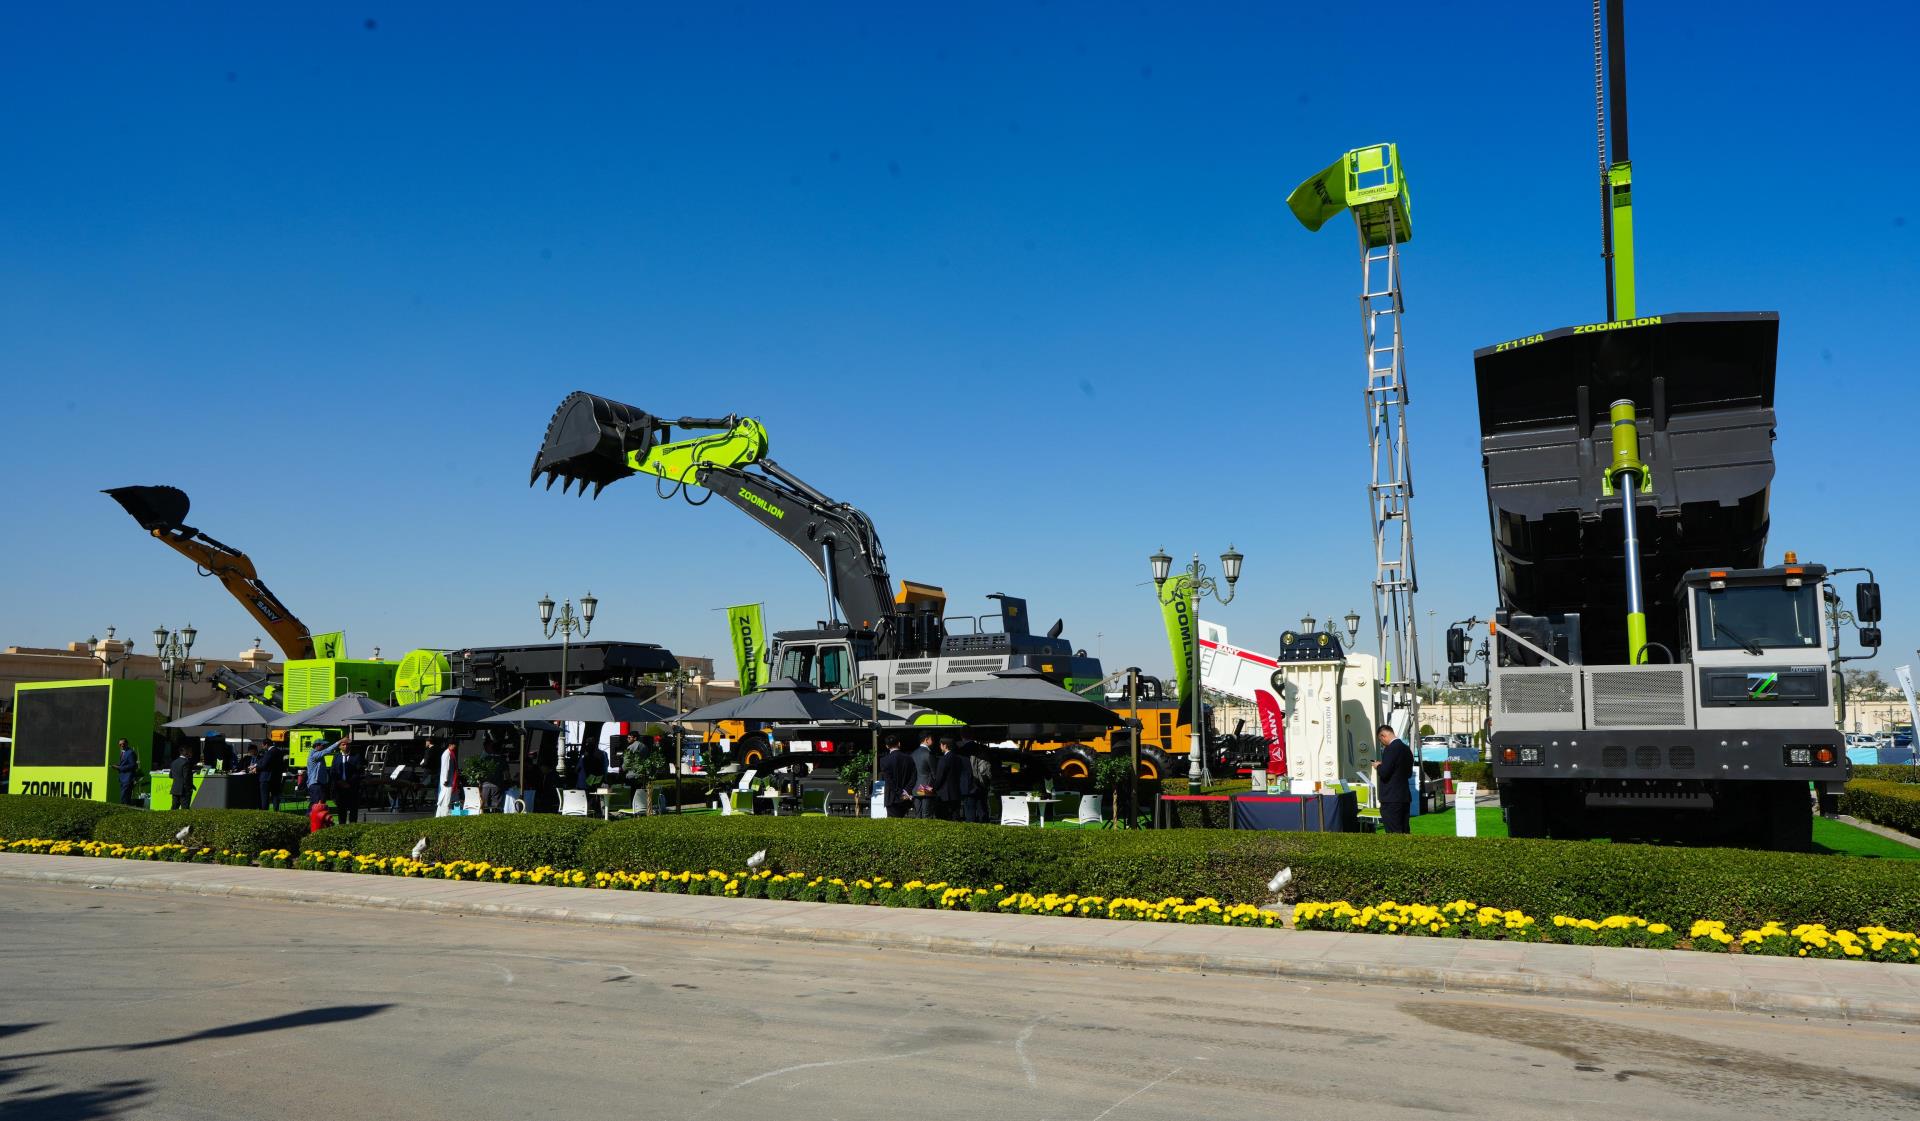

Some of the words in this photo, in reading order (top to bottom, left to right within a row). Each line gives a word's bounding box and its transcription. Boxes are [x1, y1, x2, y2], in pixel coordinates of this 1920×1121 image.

[1573, 316, 1662, 334] ZOOMLION
[1496, 334, 1544, 352] ZT115A
[738, 487, 785, 520] ZOOMLION
[256, 600, 279, 620] SANY
[739, 615, 758, 691] ZOOMLION
[1216, 643, 1240, 656] SANY
[1267, 710, 1280, 745] SANY
[21, 781, 93, 799] ZOOMLION
